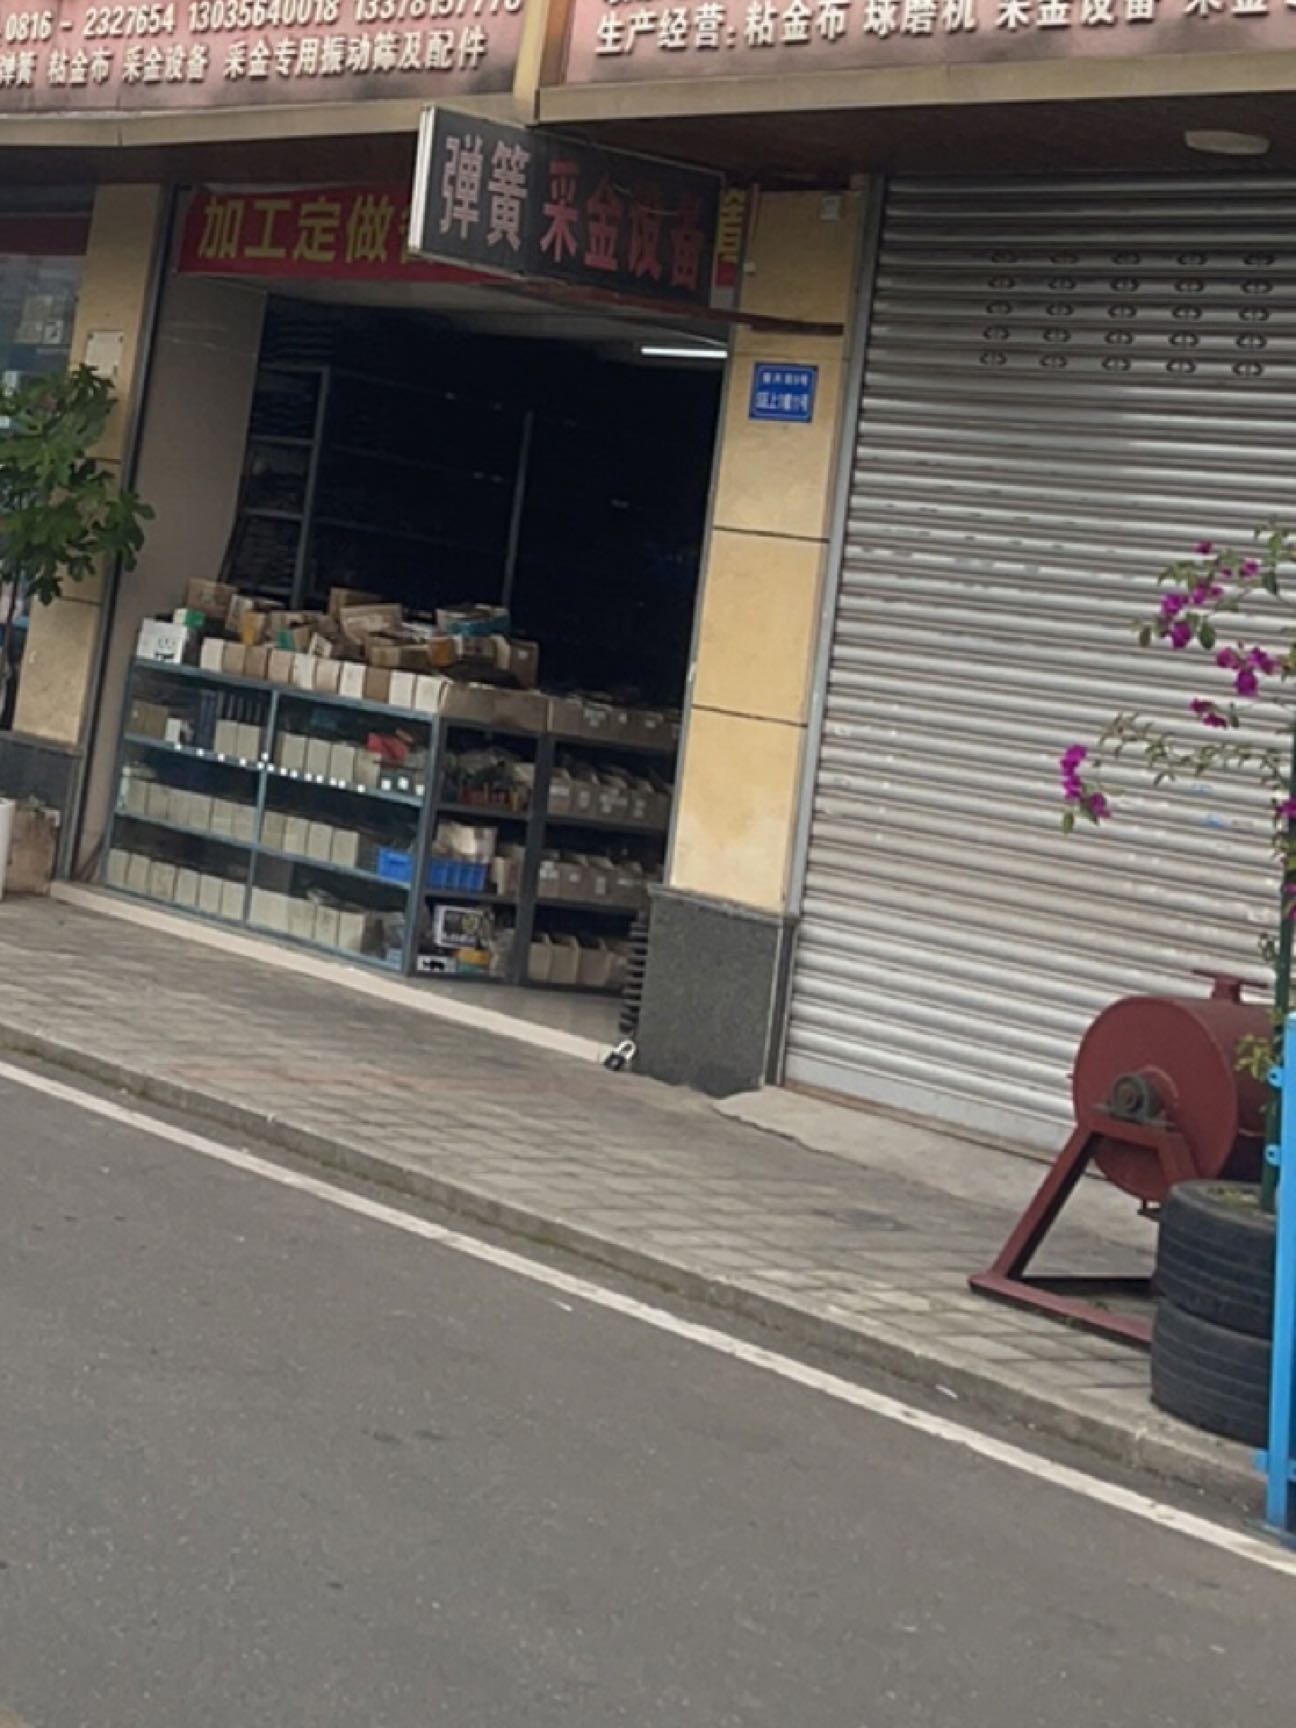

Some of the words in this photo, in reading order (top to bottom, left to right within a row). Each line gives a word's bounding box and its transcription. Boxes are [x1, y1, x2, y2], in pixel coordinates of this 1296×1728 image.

[123, 43, 209, 86] 采金设备
[197, 189, 412, 265] 加工定做
[440, 134, 531, 253] 弹簧
